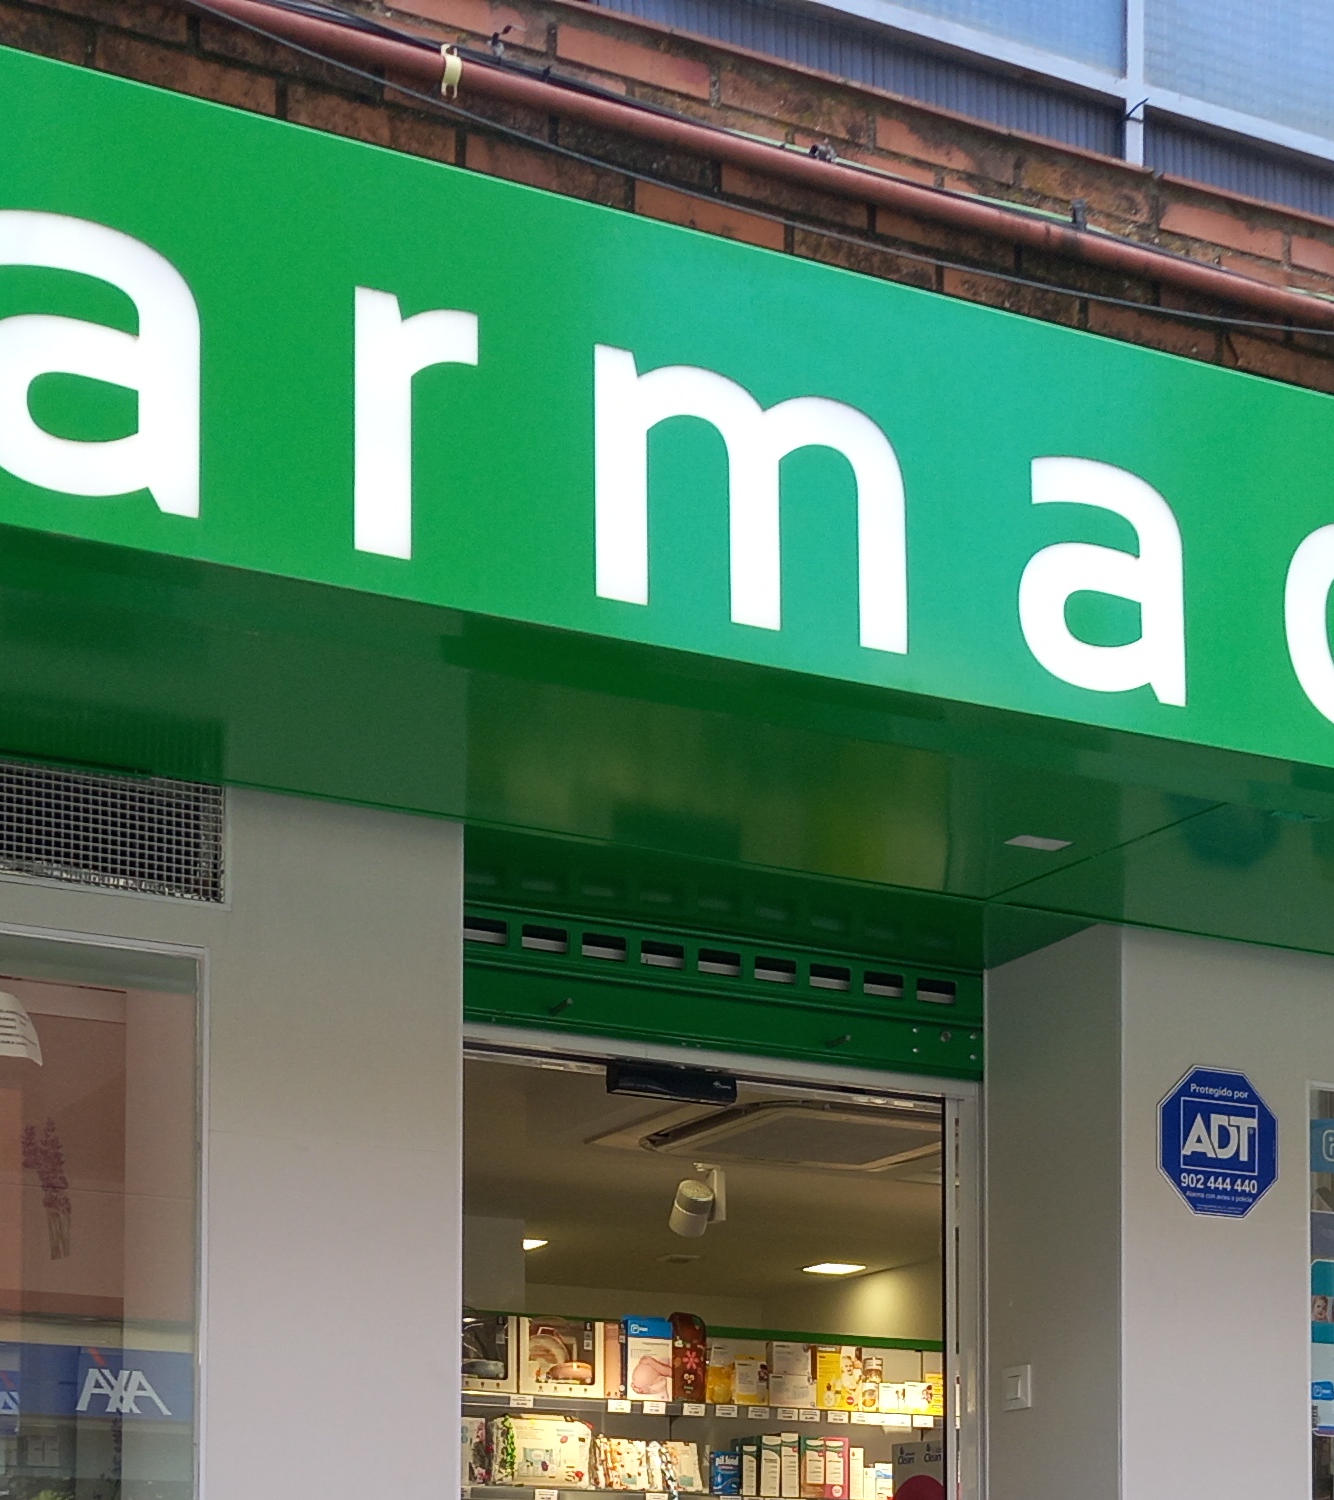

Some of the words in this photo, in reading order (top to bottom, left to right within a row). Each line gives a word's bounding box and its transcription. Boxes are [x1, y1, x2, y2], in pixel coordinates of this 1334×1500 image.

[1190, 1083, 1233, 1097] Protegido
[1234, 1091, 1248, 1099] por
[1182, 1112, 1257, 1161] ADT
[1181, 1173, 1205, 1188] 902
[1207, 1176, 1231, 1192] 444
[1234, 1179, 1257, 1194] 440
[898, 1455, 915, 1465] Clean
